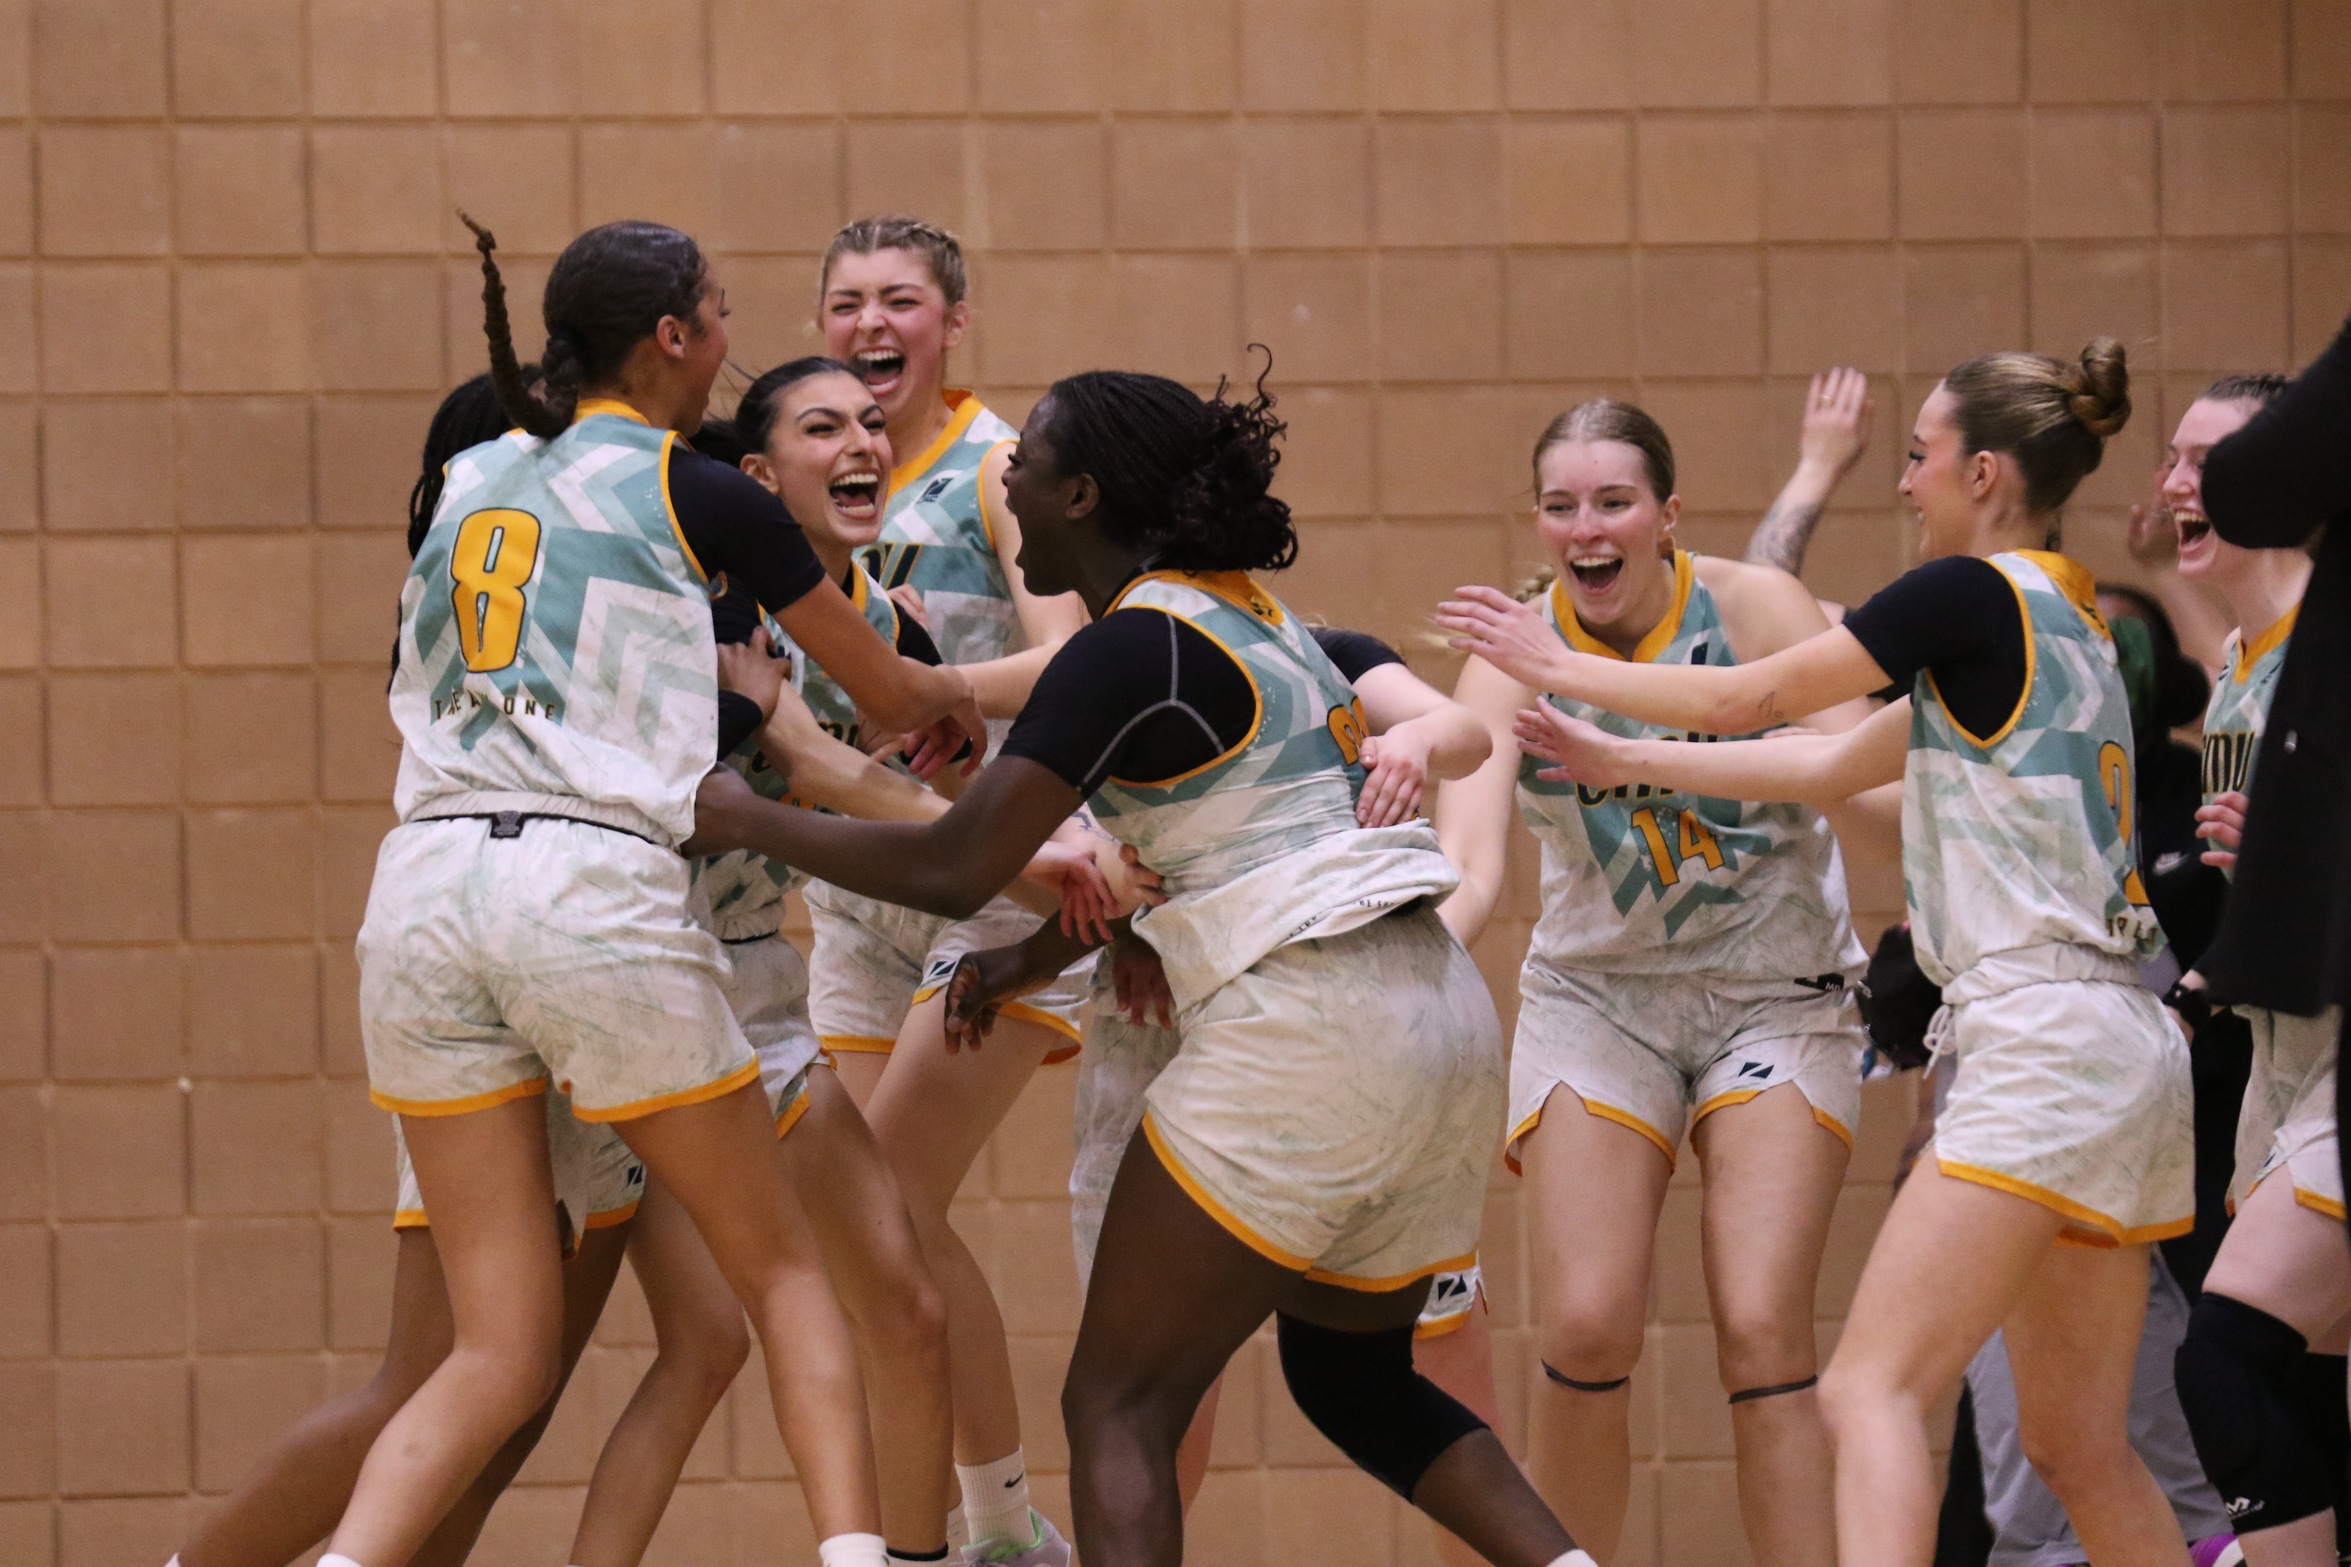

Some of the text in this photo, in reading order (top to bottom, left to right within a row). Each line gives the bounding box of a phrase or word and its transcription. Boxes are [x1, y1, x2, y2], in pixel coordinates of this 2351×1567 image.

[450, 507, 541, 673] 8
[503, 697, 555, 720] ONE
[1631, 806, 1726, 887] 14
